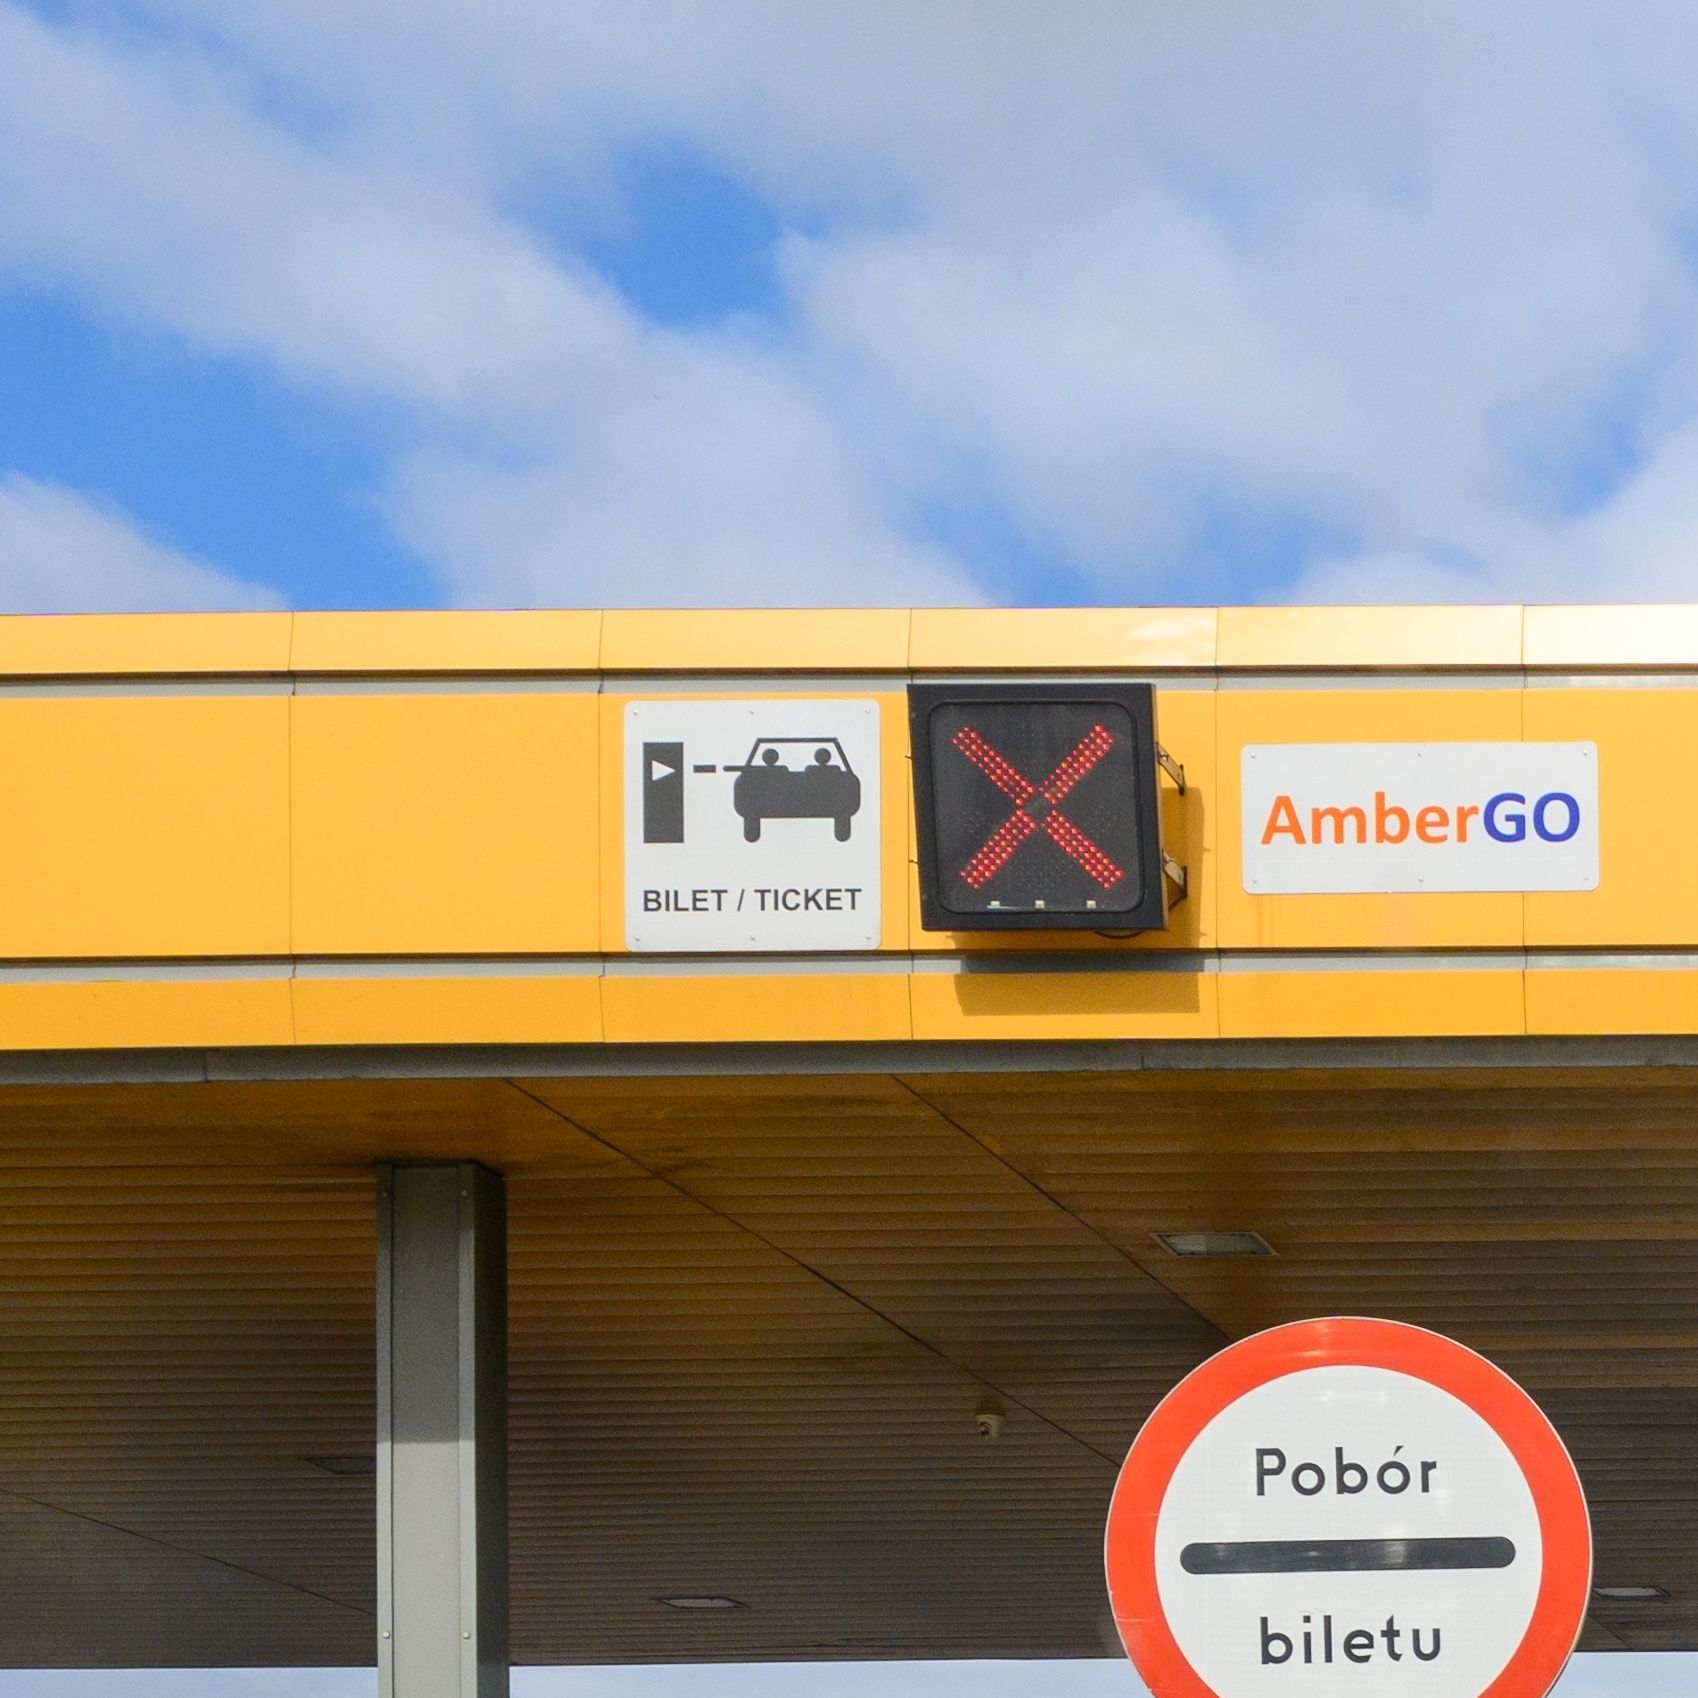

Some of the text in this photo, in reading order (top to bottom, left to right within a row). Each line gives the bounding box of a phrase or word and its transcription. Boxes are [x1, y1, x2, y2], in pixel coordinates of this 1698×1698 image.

[1260, 790, 1581, 846] AmberGO
[643, 889, 728, 912] BILET
[754, 888, 862, 911] TICKET
[1255, 1445, 1437, 1496] Pobór
[1260, 1614, 1441, 1665] biletu
